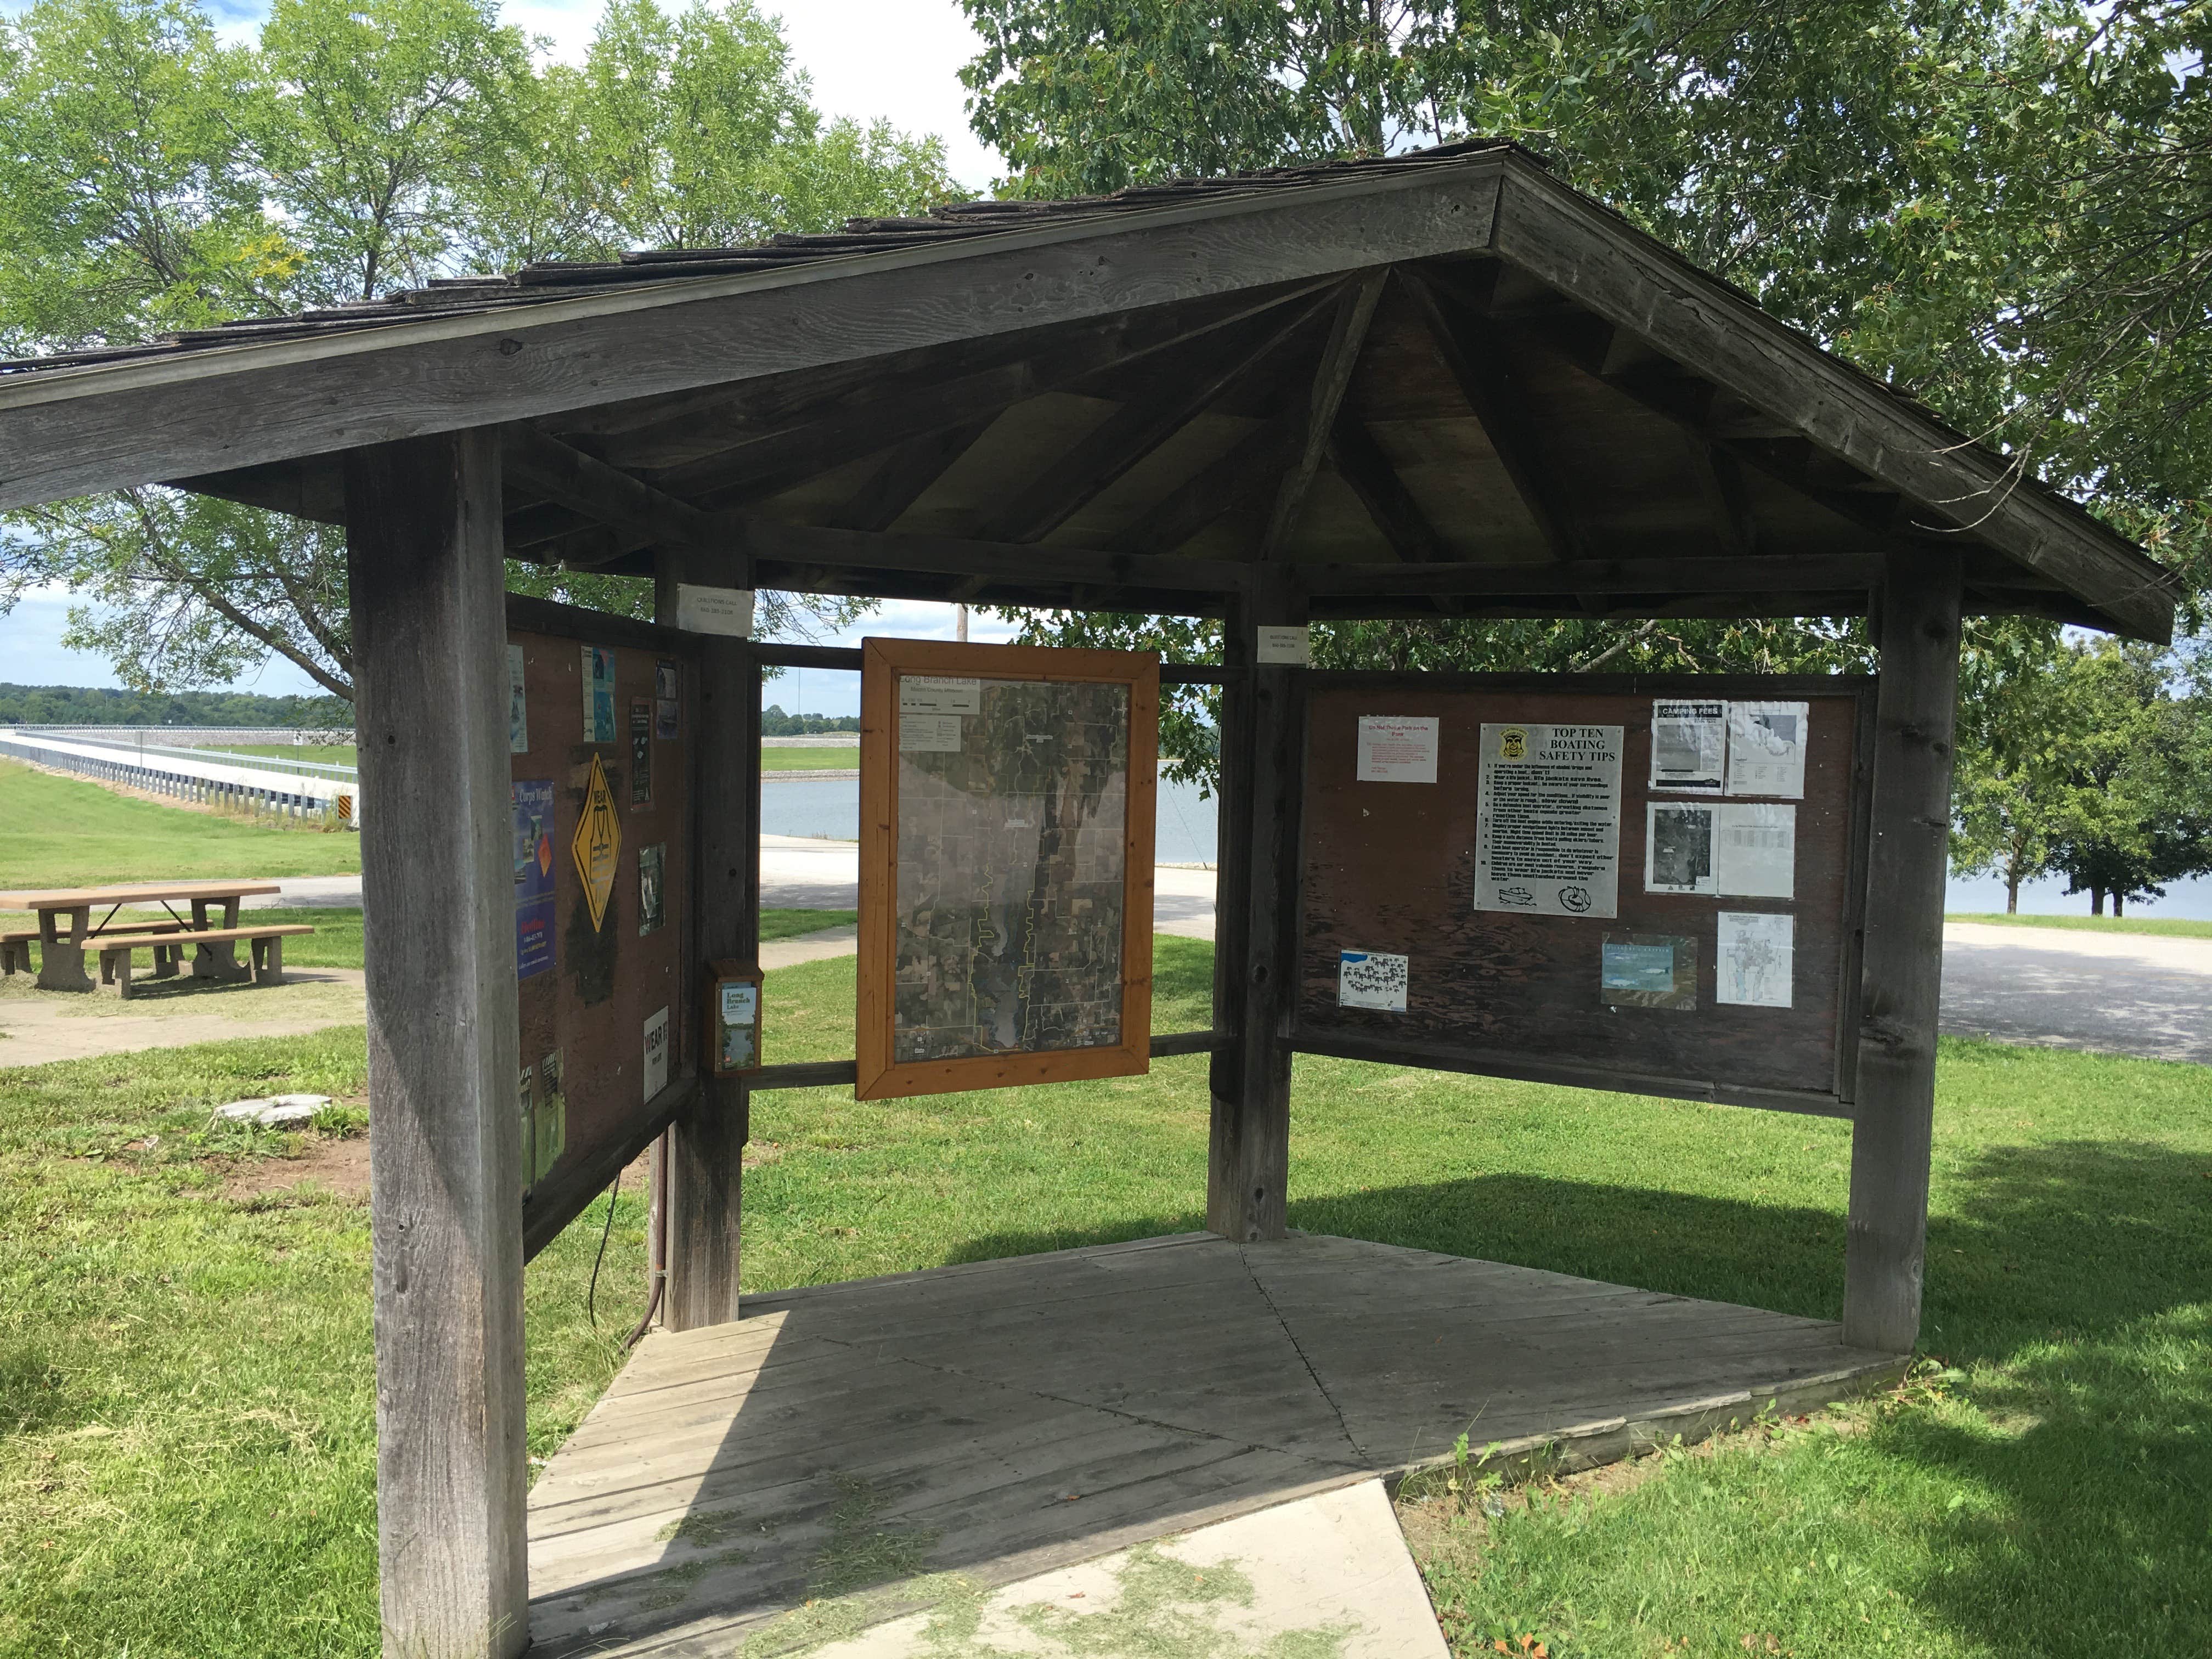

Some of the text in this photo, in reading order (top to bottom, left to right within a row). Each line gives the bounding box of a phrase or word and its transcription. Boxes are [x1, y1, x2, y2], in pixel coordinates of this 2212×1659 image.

[900, 676, 977, 685] Long Branch Lake
[1552, 728, 1604, 738] TOP TEN
[1550, 740, 1605, 750] BOATING
[1539, 751, 1615, 761] SAFETY TIPS
[519, 788, 535, 805] Corps
[594, 790, 606, 804] WEAR
[645, 1025, 662, 1054] WEAR
